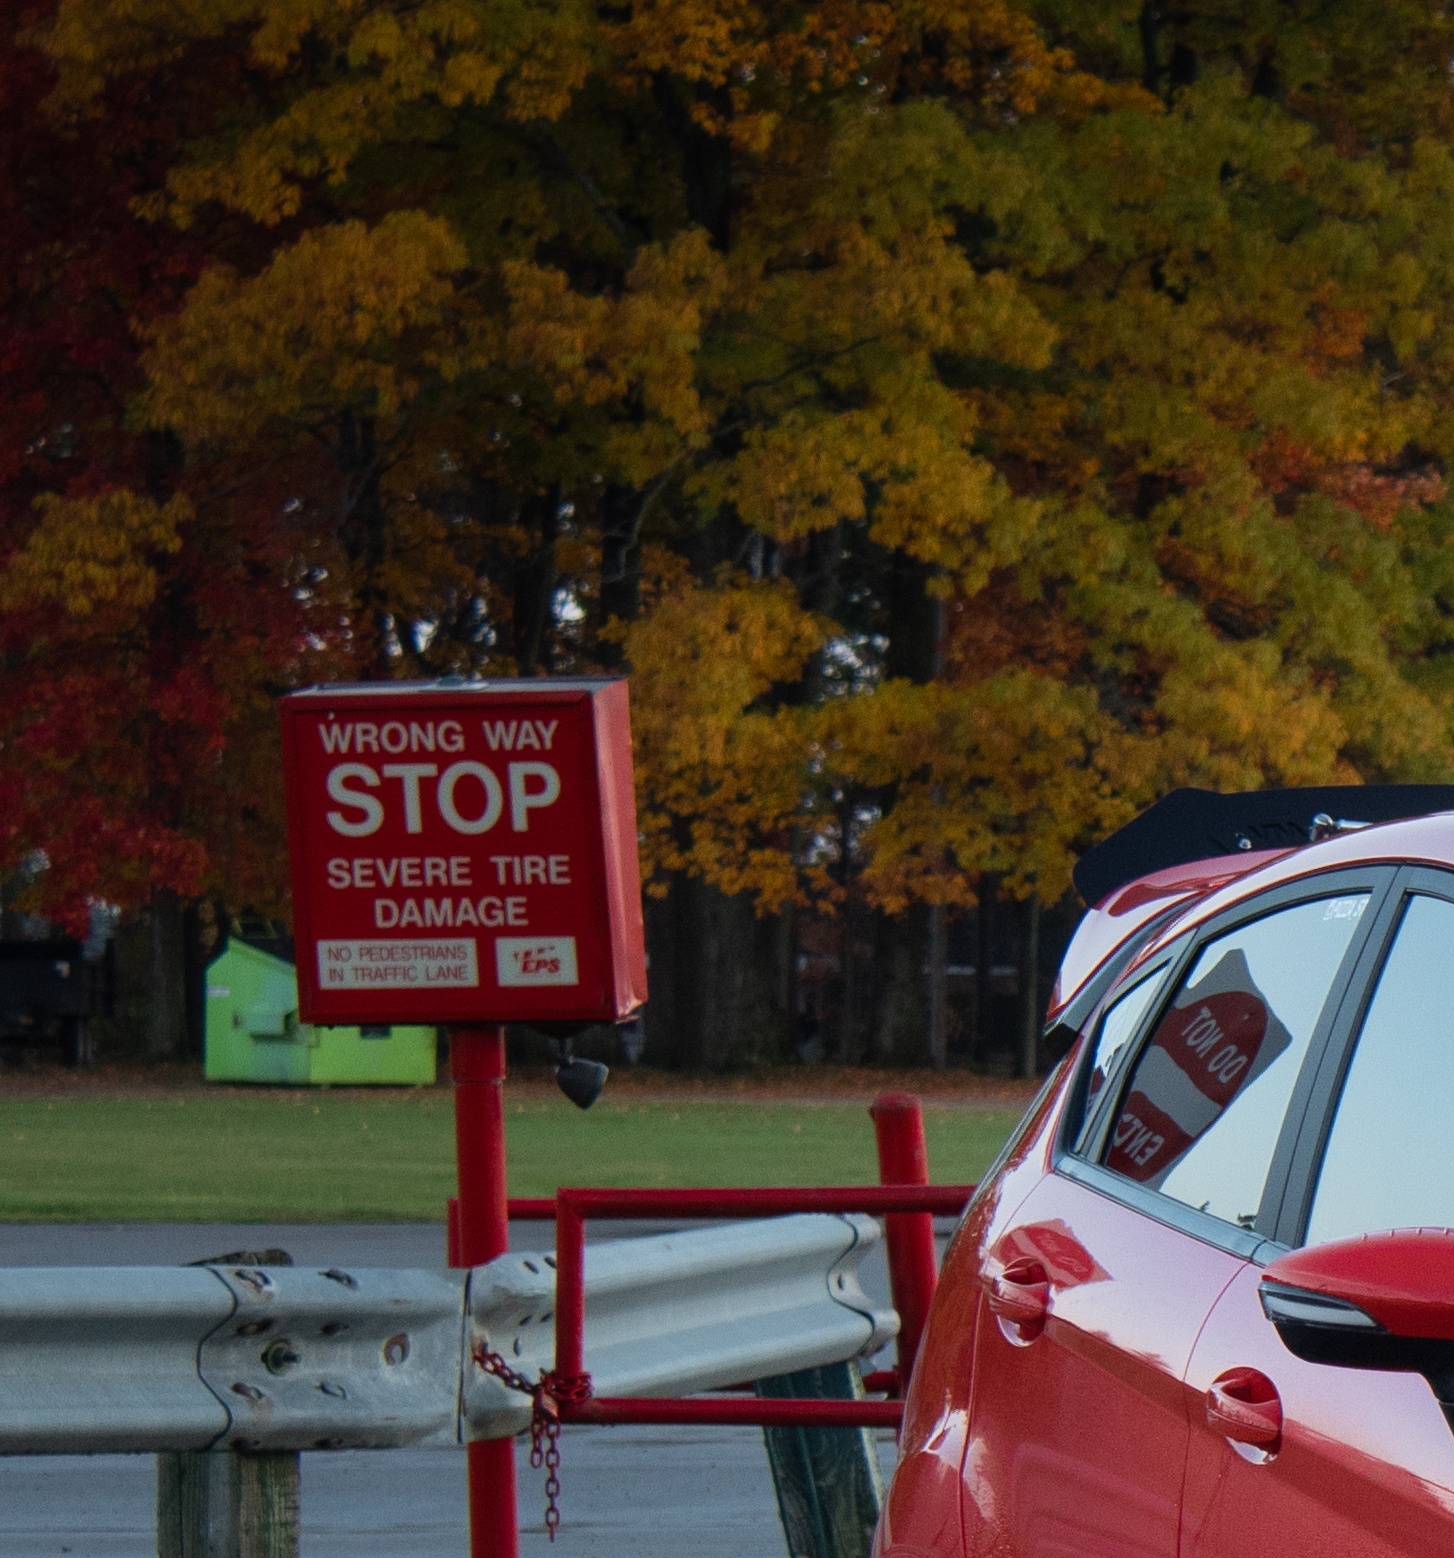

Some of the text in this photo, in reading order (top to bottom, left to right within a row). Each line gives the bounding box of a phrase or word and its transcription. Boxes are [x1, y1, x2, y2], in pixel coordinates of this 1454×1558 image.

[318, 720, 559, 754] WRONG WAY
[325, 760, 561, 837] STOP
[326, 855, 571, 889] SEVERE TIRE
[374, 896, 529, 929] DAMAGE
[327, 944, 469, 963] NO PEDESTRIANS
[328, 964, 470, 982] IN TRAFFIC LANE
